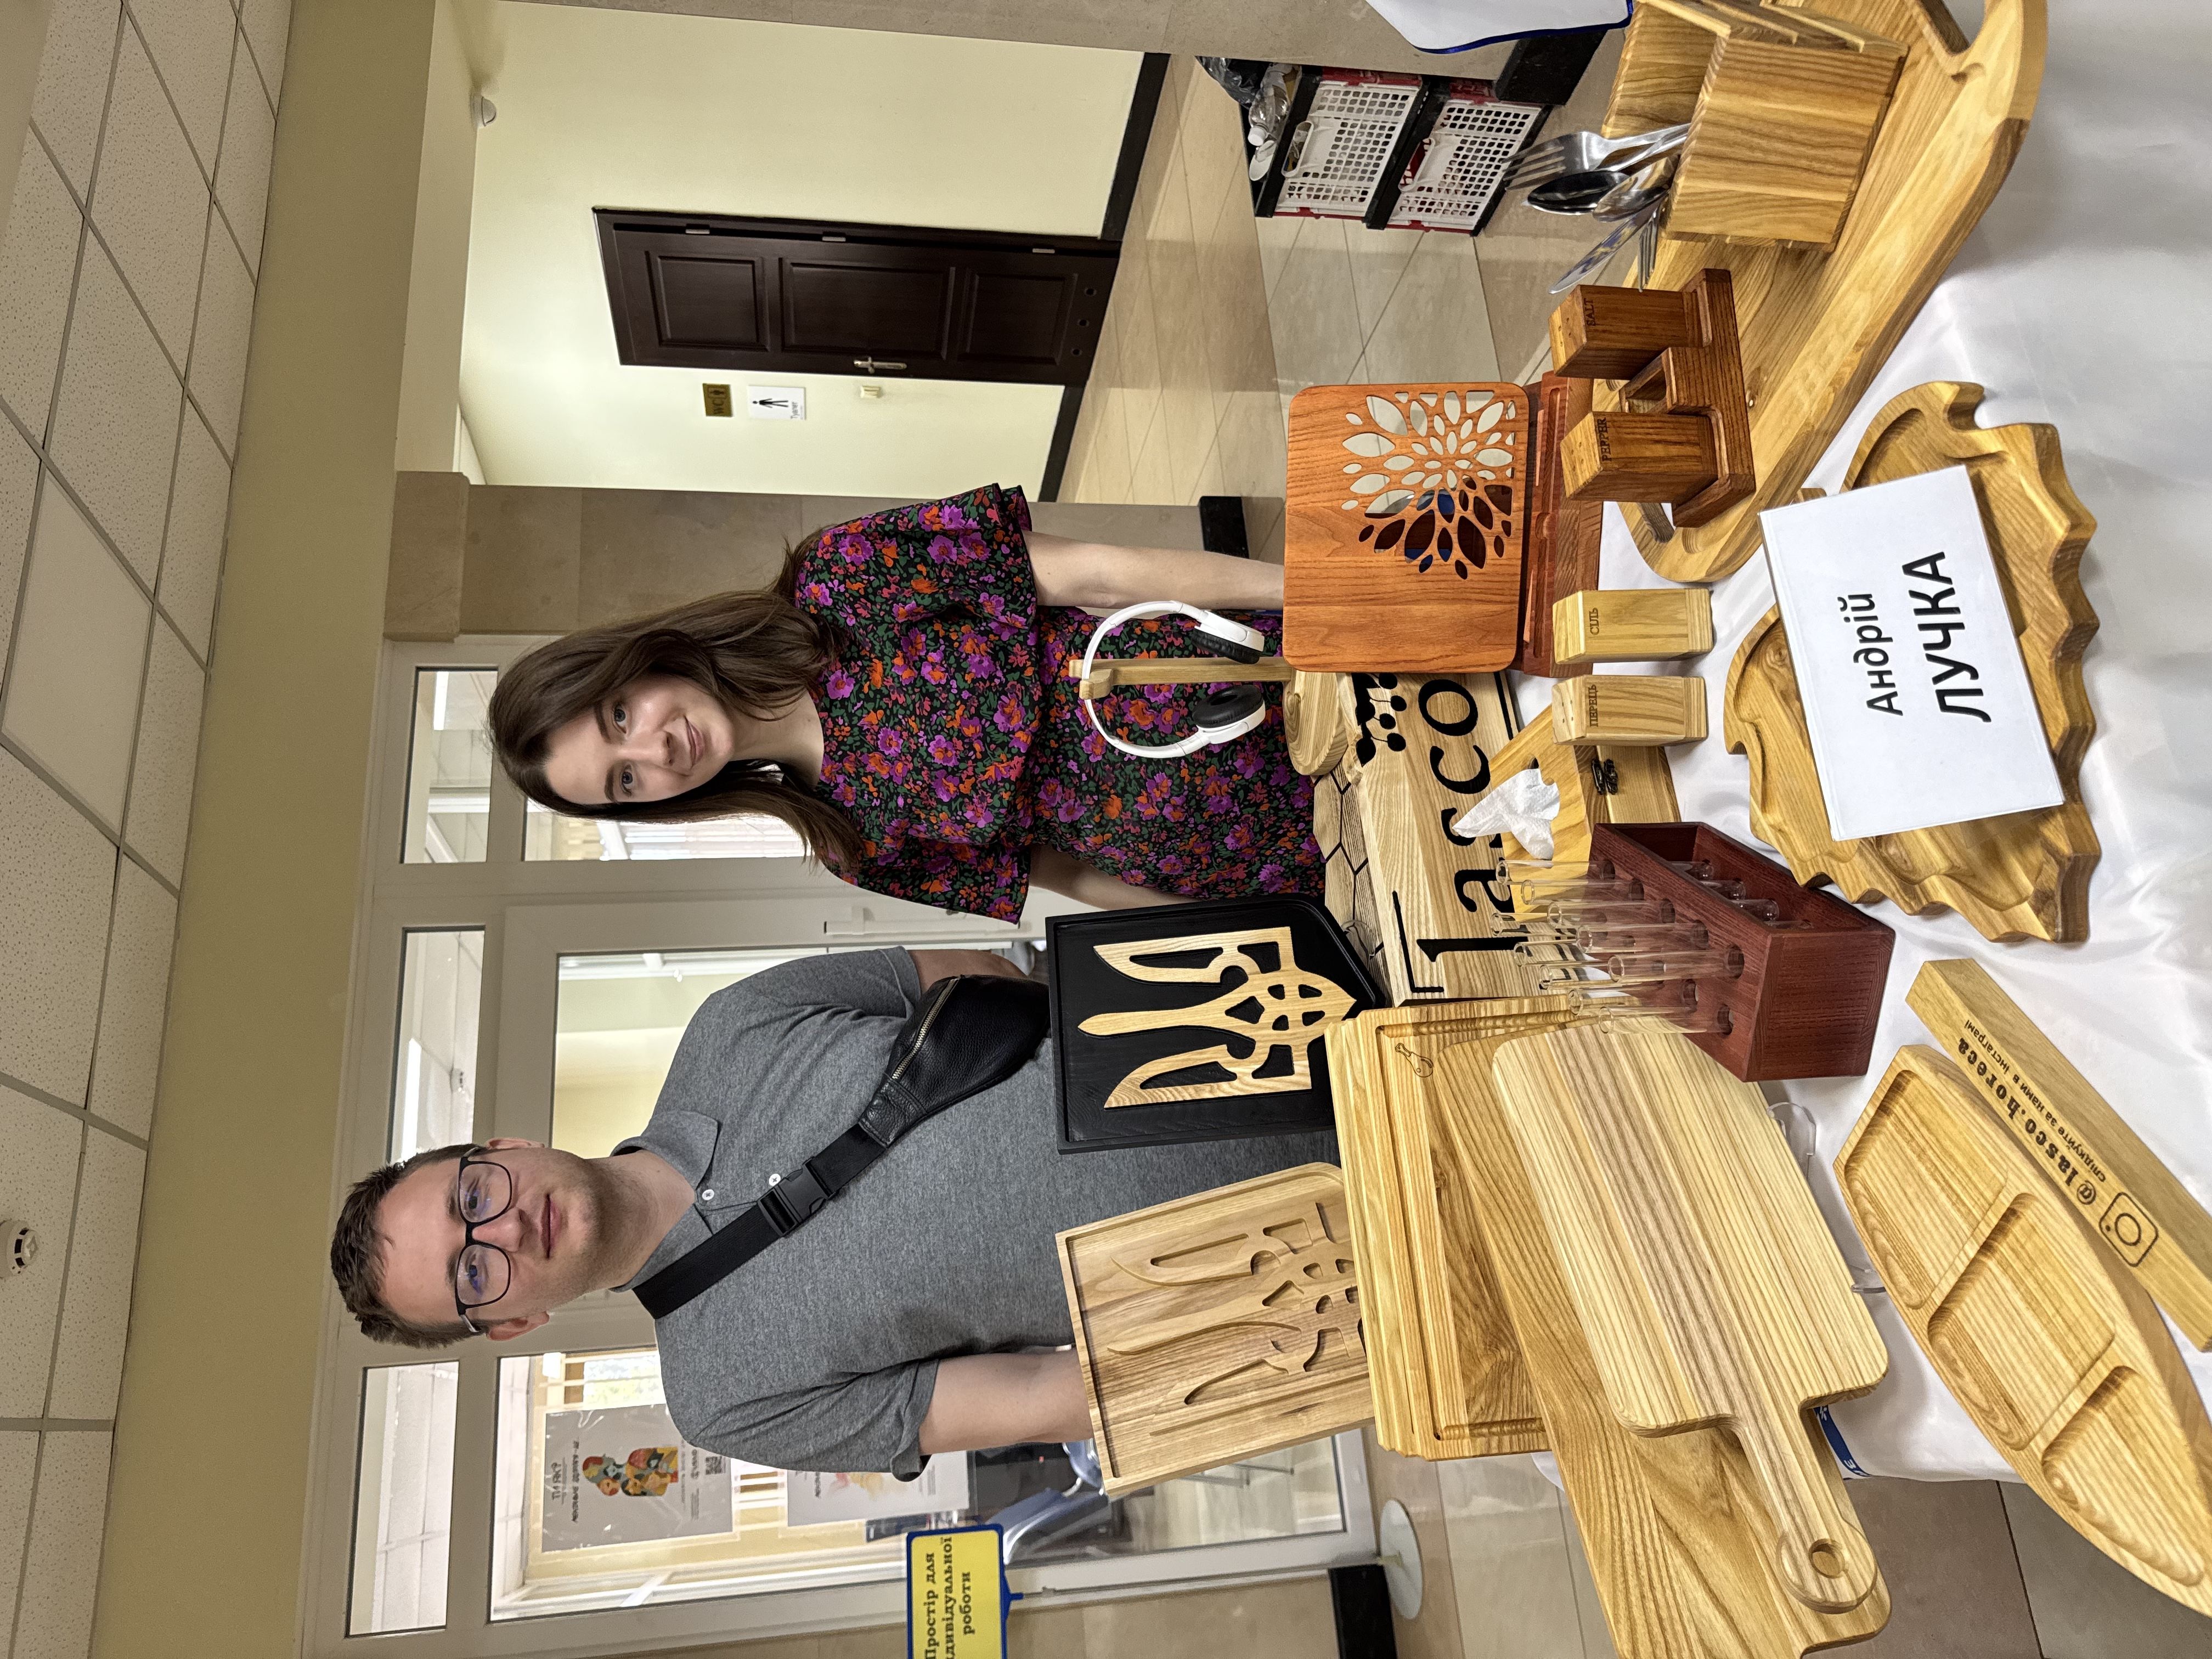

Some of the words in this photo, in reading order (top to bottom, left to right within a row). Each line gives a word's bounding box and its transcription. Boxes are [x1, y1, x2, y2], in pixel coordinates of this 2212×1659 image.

[1584, 297, 1596, 326] SALT
[712, 399, 724, 415] WC
[1597, 417, 1611, 461] PEPPER
[1588, 607, 1600, 635] СІЛЬ
[1901, 551, 1991, 723] ЛУЧКА
[1837, 592, 1903, 716] Андрій
[1588, 684, 1599, 727] ПЕРЕЦЬ
[1965, 1019, 2009, 1073] інстаграмі
[2012, 1075, 2020, 1083] в
[2020, 1082, 2044, 1112] нами
[2044, 1111, 2058, 1126] за
[2057, 1127, 2107, 1183] слідкуйте
[926, 1553, 936, 1584] для
[940, 1537, 956, 1658] дивідуальної
[959, 1571, 975, 1635] роботи
[923, 1590, 939, 1658] Простір
